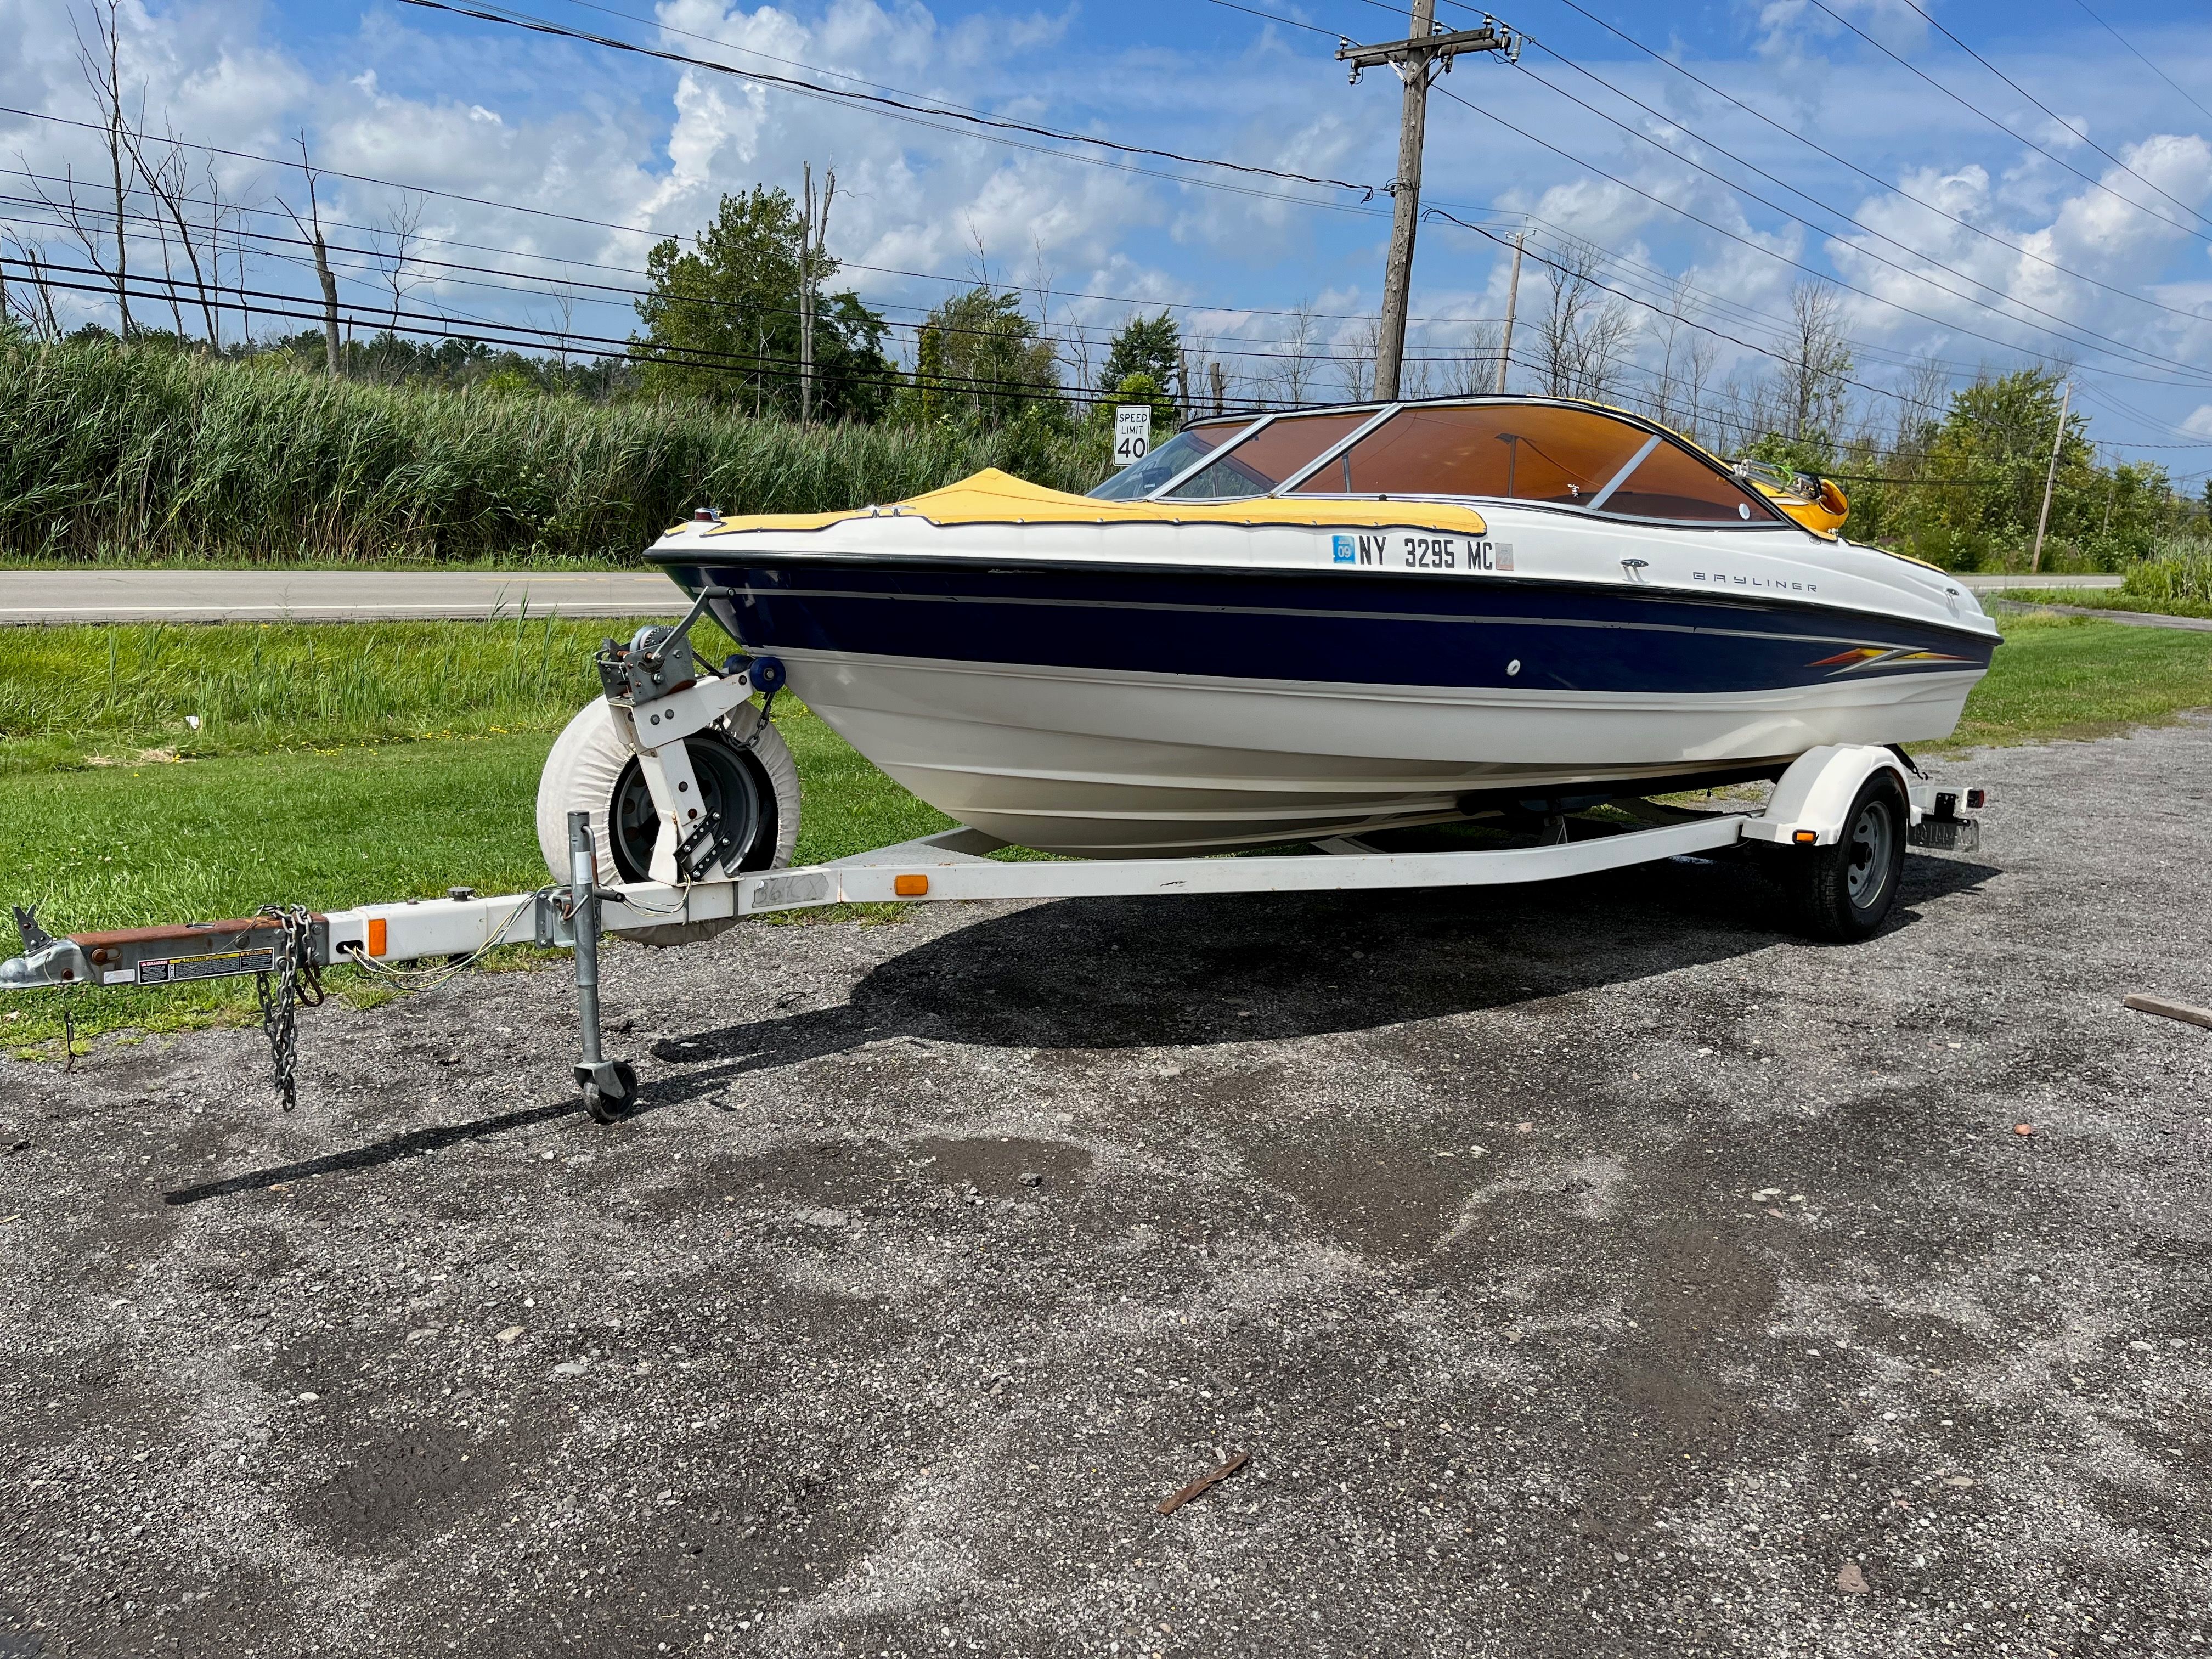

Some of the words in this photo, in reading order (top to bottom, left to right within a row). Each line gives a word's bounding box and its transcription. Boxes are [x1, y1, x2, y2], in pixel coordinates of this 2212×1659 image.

[1119, 414, 1147, 422] SPEED
[1121, 426, 1143, 434] LIMIT
[1117, 437, 1146, 458] 40
[1338, 545, 1351, 558] 09
[1359, 535, 1386, 565] NY
[1404, 538, 1455, 568] 3295
[1468, 541, 1493, 570] MC
[1693, 572, 1817, 592] BAYLINER
